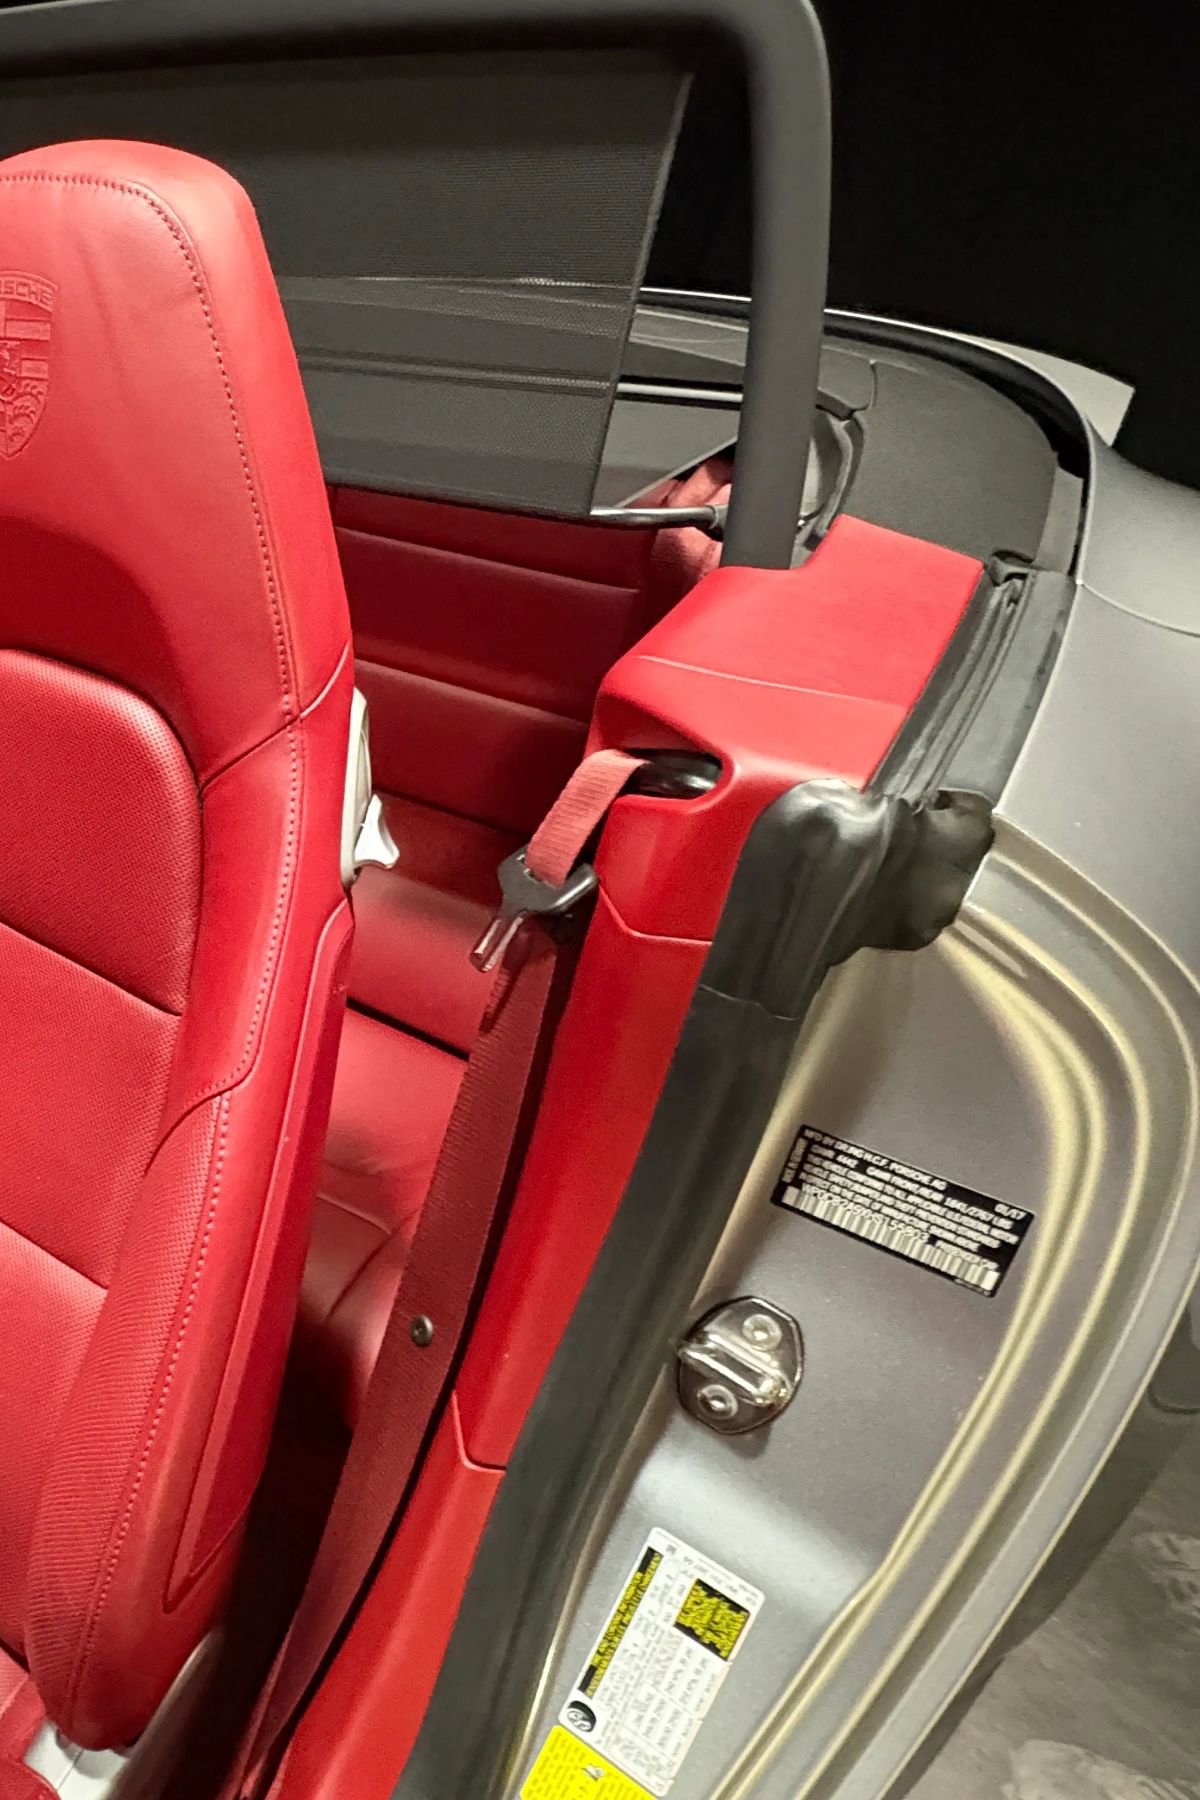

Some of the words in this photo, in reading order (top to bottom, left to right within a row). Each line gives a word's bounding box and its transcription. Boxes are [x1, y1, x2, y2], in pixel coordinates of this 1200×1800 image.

[888, 1161, 932, 1184] PORSCHE
[930, 1177, 947, 1190] AG
[882, 1183, 895, 1195] TO
[993, 1202, 1027, 1222] 01/17
[991, 1214, 1014, 1231] LBS
